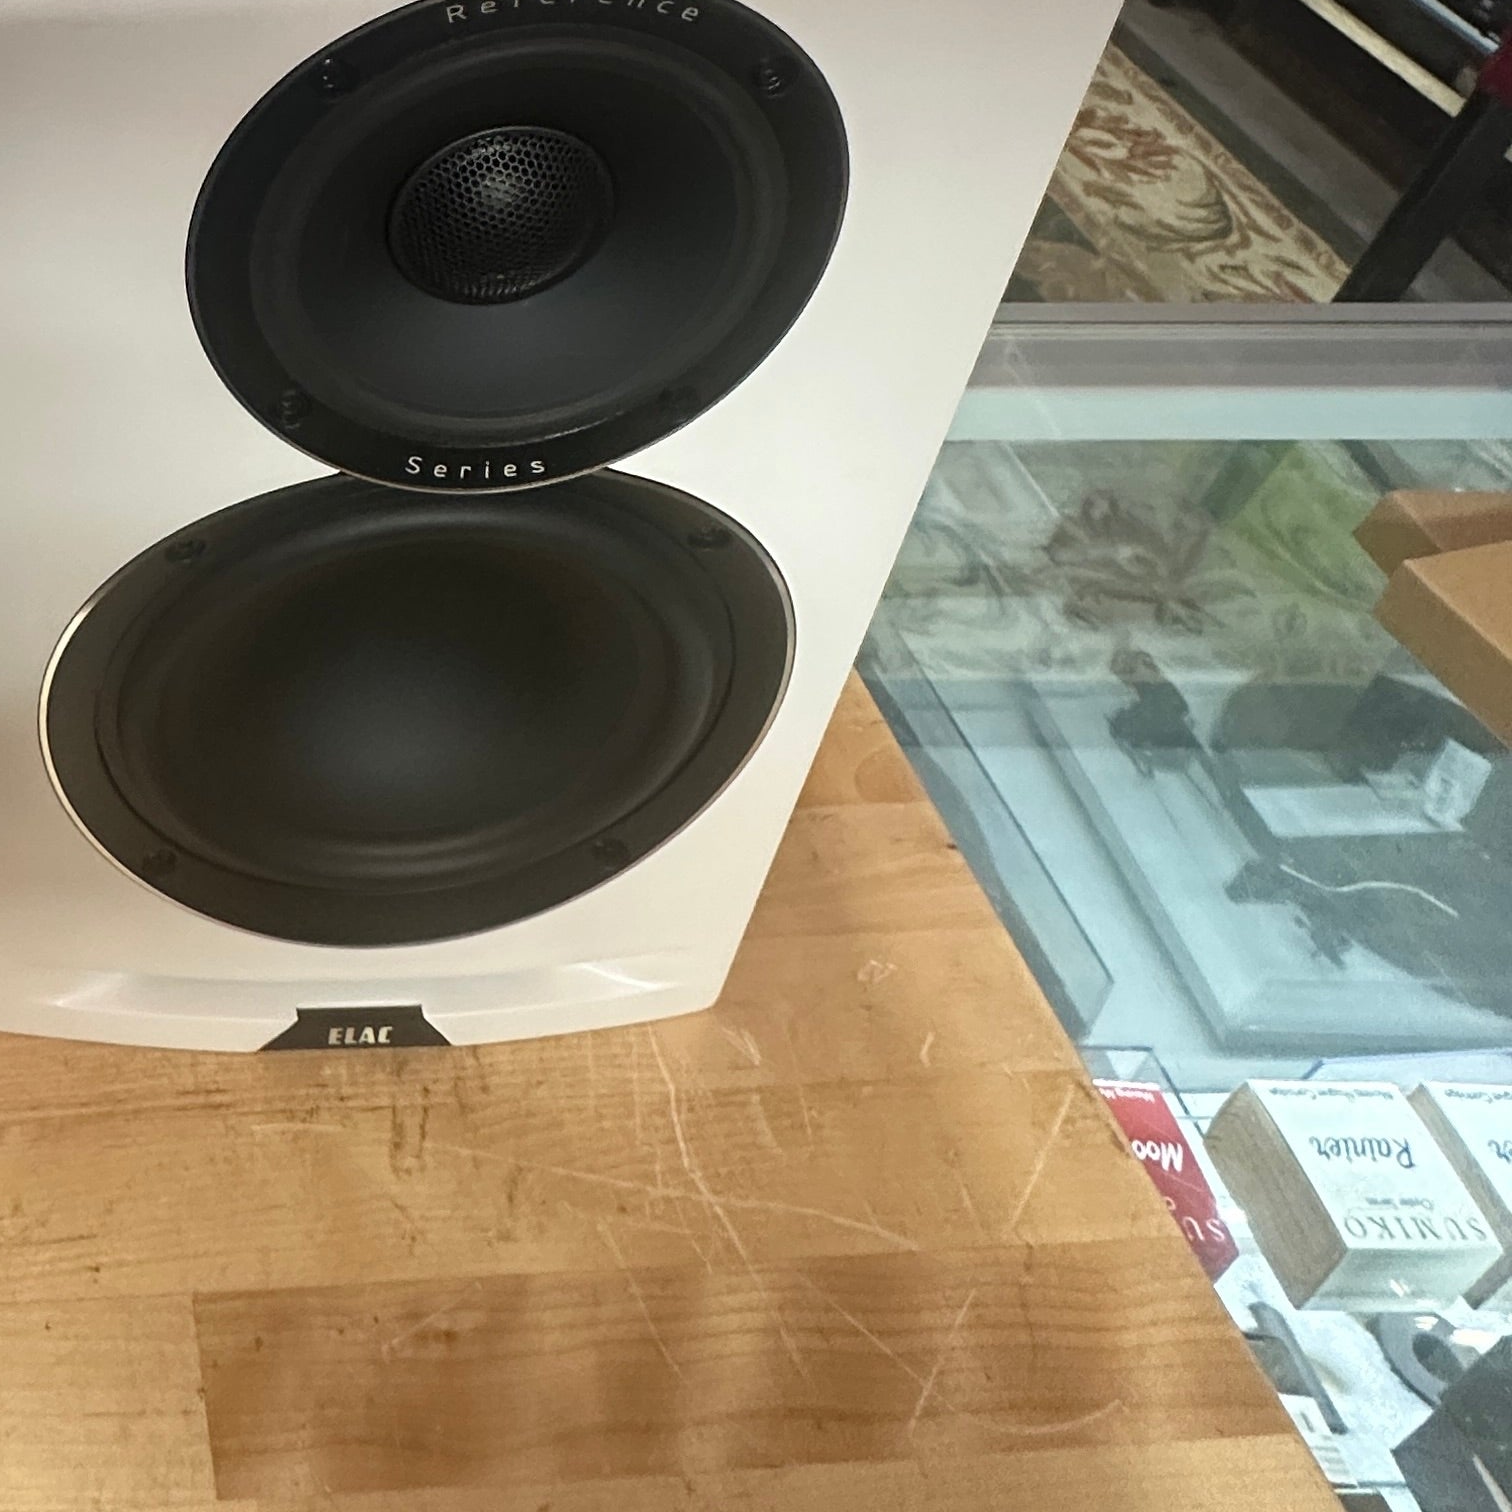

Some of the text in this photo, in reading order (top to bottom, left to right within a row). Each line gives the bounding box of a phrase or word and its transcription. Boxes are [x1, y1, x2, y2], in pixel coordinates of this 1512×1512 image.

[404, 456, 546, 479] Series
[327, 1026, 393, 1046] ELAC
[1309, 1136, 1416, 1168] Rainier
[1344, 1216, 1488, 1241] SUMIKO
